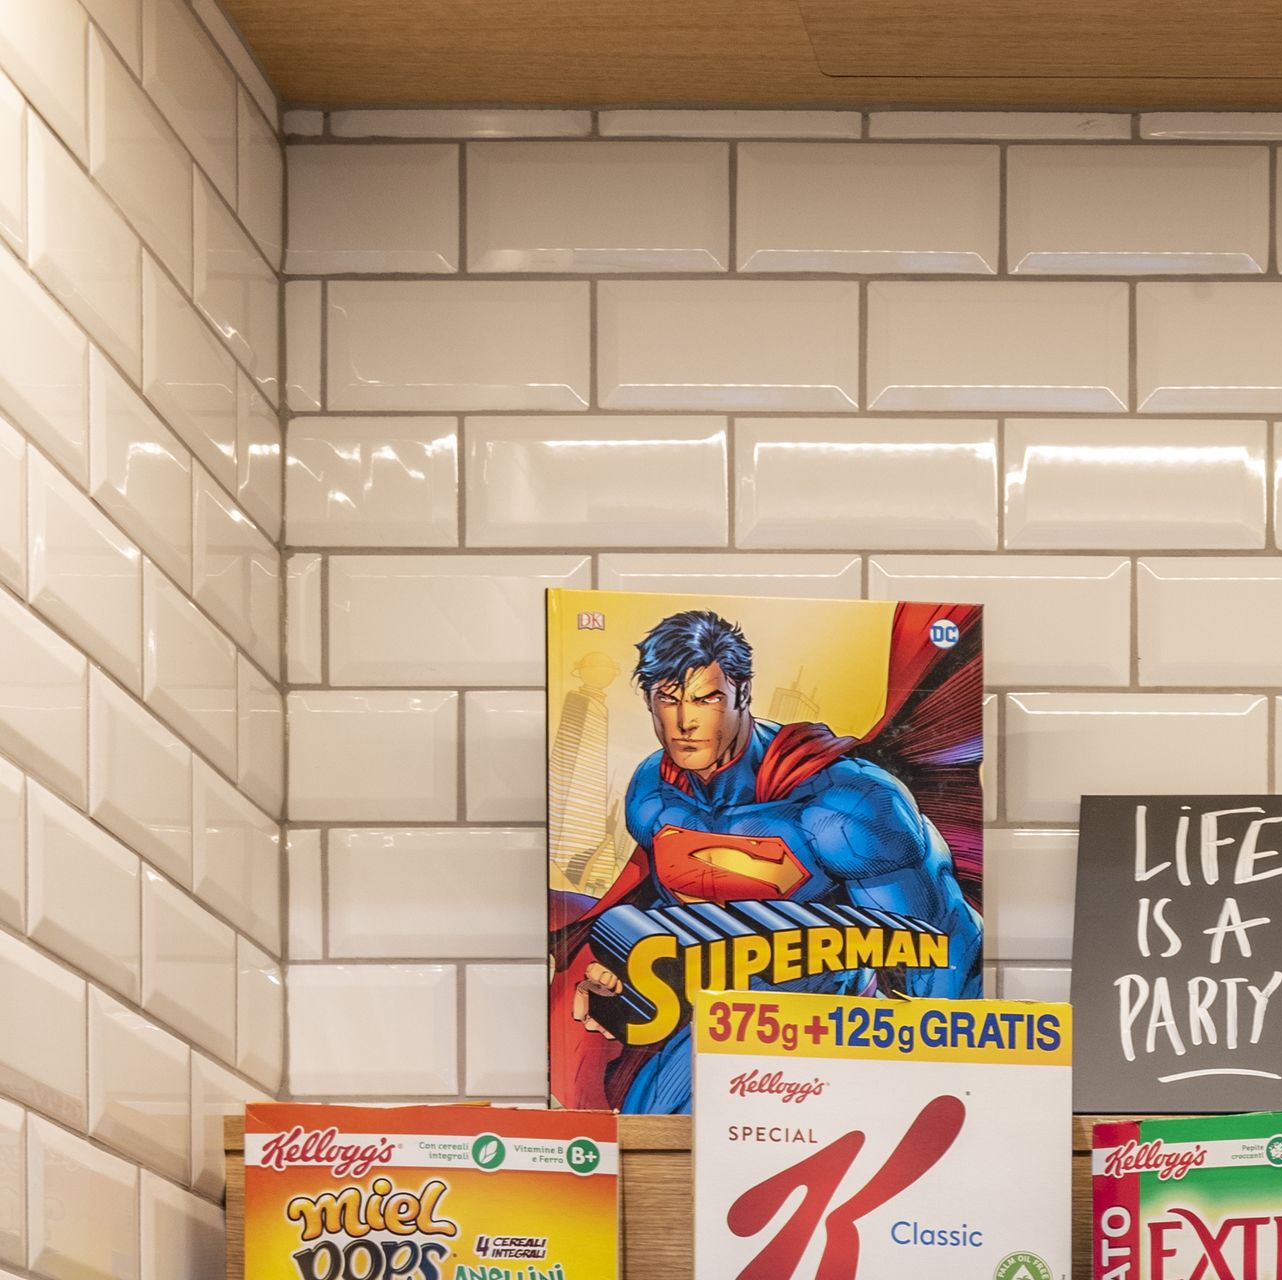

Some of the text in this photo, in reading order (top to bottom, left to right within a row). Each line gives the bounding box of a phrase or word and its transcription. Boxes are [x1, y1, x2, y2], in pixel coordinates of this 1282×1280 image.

[580, 612, 602, 628] DK
[931, 625, 957, 643] DC
[1137, 898, 1271, 964] IS A
[625, 926, 950, 1046] SUPERMAN
[920, 1009, 1062, 1052] GRATIS
[728, 1068, 826, 1104] Kellogg's
[728, 1126, 819, 1144] SPECIAL
[261, 1126, 396, 1178] Kellogg's
[429, 1152, 469, 1162] integrali
[438, 1143, 469, 1151] cereali
[514, 1144, 556, 1154] Vitamine
[539, 1156, 564, 1164] Ferro
[1104, 1140, 1208, 1179] Kellogg's
[890, 1219, 984, 1248] Classic
[475, 1235, 547, 1257] 4 CEREALI
[491, 1248, 547, 1259] INTEGRALI
[997, 1257, 1050, 1280] PALM FREE
